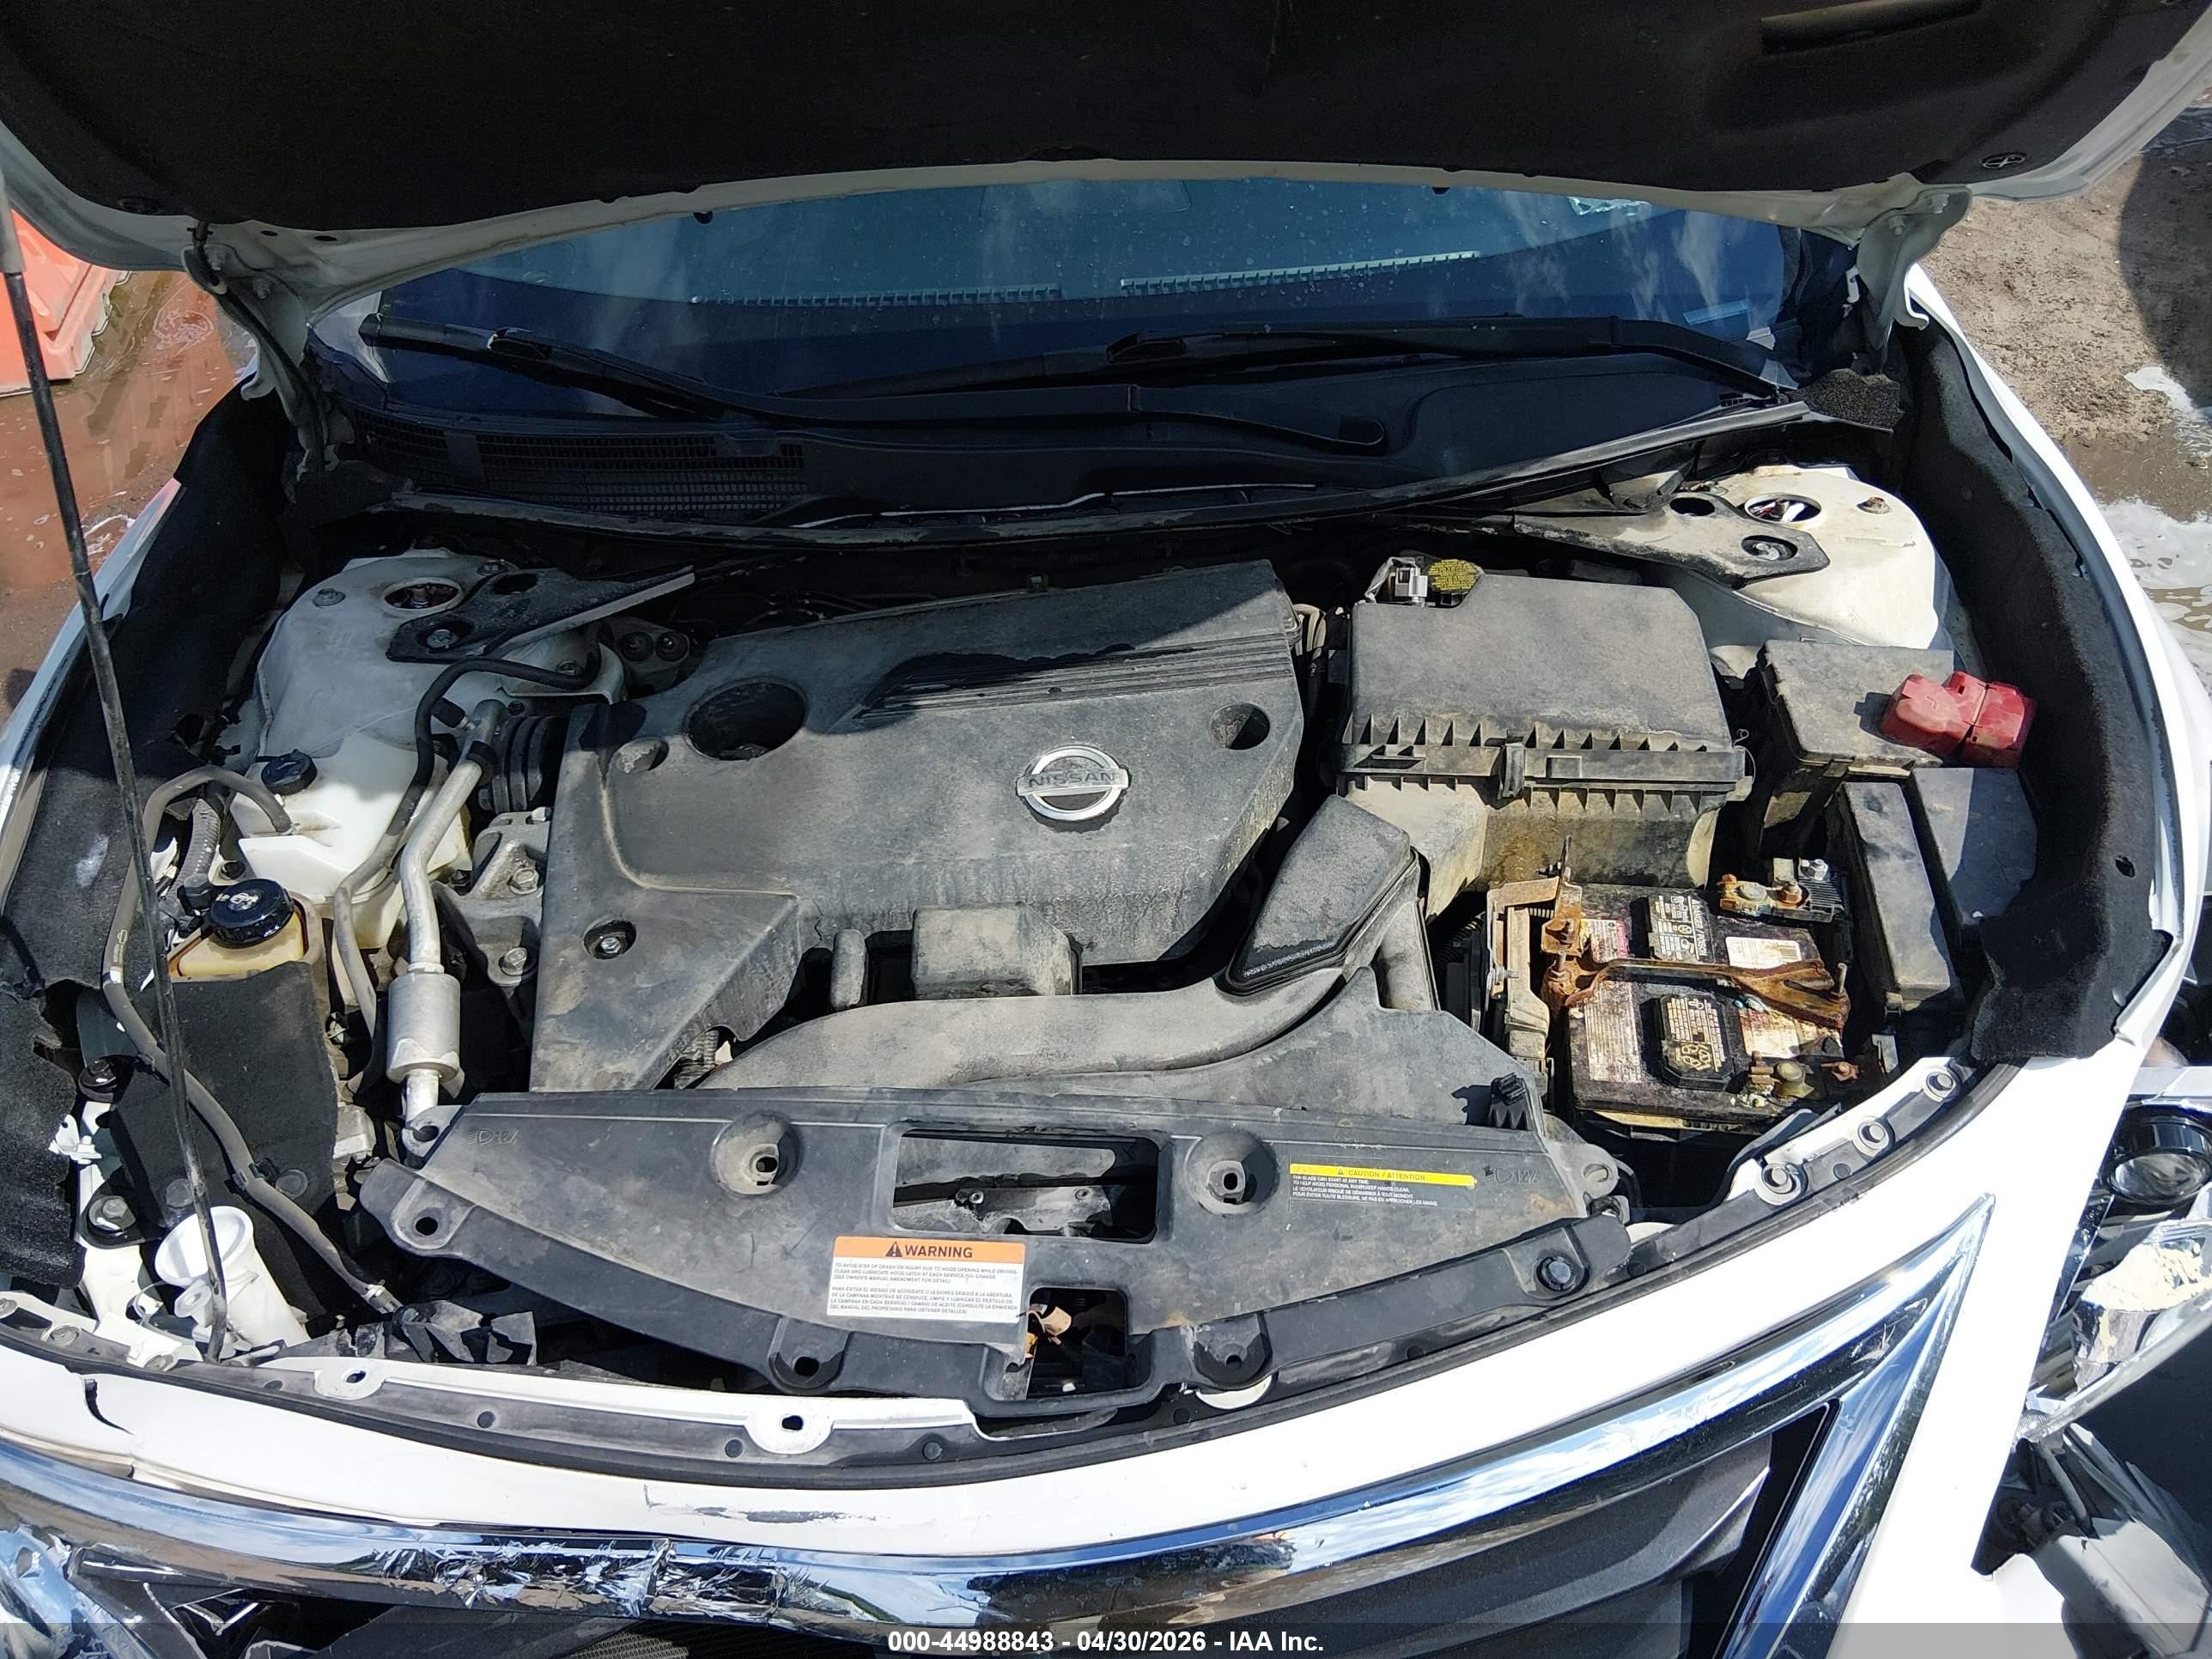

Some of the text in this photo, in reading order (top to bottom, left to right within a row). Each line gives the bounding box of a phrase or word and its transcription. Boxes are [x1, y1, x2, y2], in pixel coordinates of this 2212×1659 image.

[1029, 773, 1115, 787] NISSAN
[1692, 905, 1703, 929] DANGER
[1697, 934, 1707, 957] POISON
[1388, 1172, 1425, 1181] ATTENTION
[905, 1245, 973, 1258] WARNING
